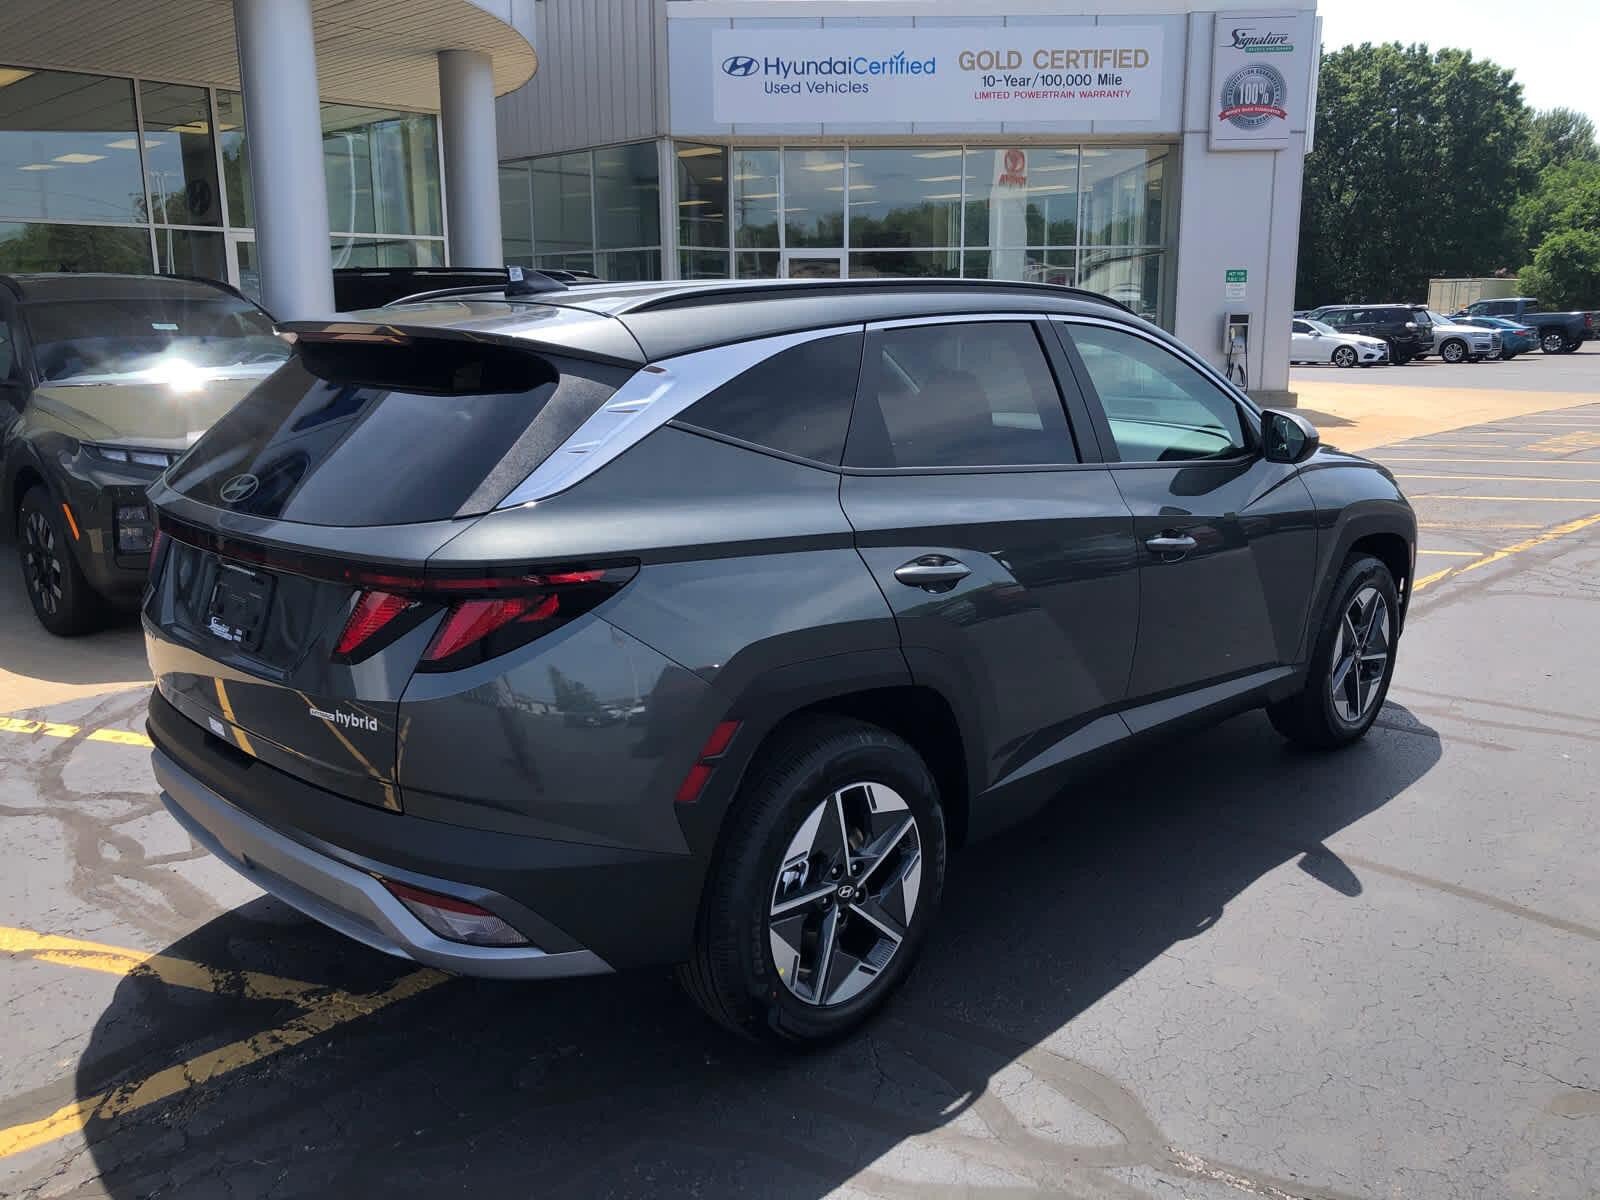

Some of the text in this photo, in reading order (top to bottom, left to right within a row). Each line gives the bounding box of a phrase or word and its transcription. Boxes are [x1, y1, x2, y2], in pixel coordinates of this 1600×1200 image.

[1220, 28, 1289, 49] Signature
[764, 51, 936, 79] HyundaiCertified
[958, 49, 1149, 71] GOLD CERTIFIED
[764, 81, 869, 94] Used Vehicles
[982, 72, 1123, 88] 10-Year/100,000 Mile
[974, 90, 1131, 99] LIMITED POWERTRAIN WARRANTY
[1239, 82, 1270, 105] 100%
[336, 709, 378, 731] hybrid
